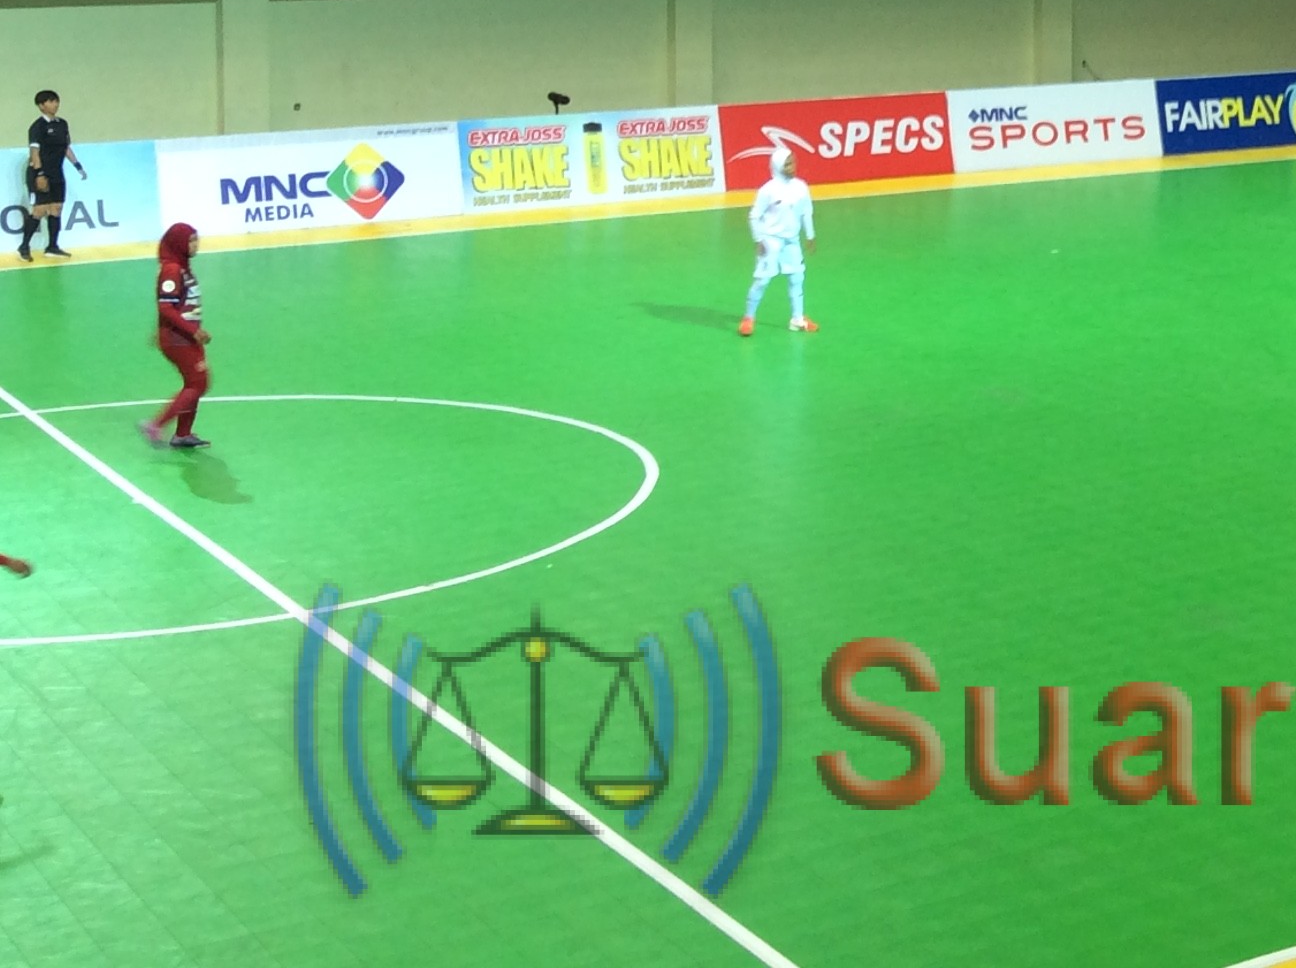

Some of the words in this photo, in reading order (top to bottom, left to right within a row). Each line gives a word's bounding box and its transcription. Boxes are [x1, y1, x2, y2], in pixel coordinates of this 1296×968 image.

[617, 119, 667, 138] EXTRA
[669, 116, 709, 134] JOSS
[980, 105, 1027, 122] MNC
[1164, 94, 1287, 133] FAIRPLAY
[469, 129, 520, 147] EXTRA
[523, 125, 566, 143] JOSS
[818, 115, 945, 159] SPECS
[969, 114, 1146, 150] SPORTS
[469, 145, 571, 193] SHAKE
[618, 135, 714, 181] SHAKE
[220, 170, 333, 205] MNC
[245, 203, 314, 223] MEDIA
